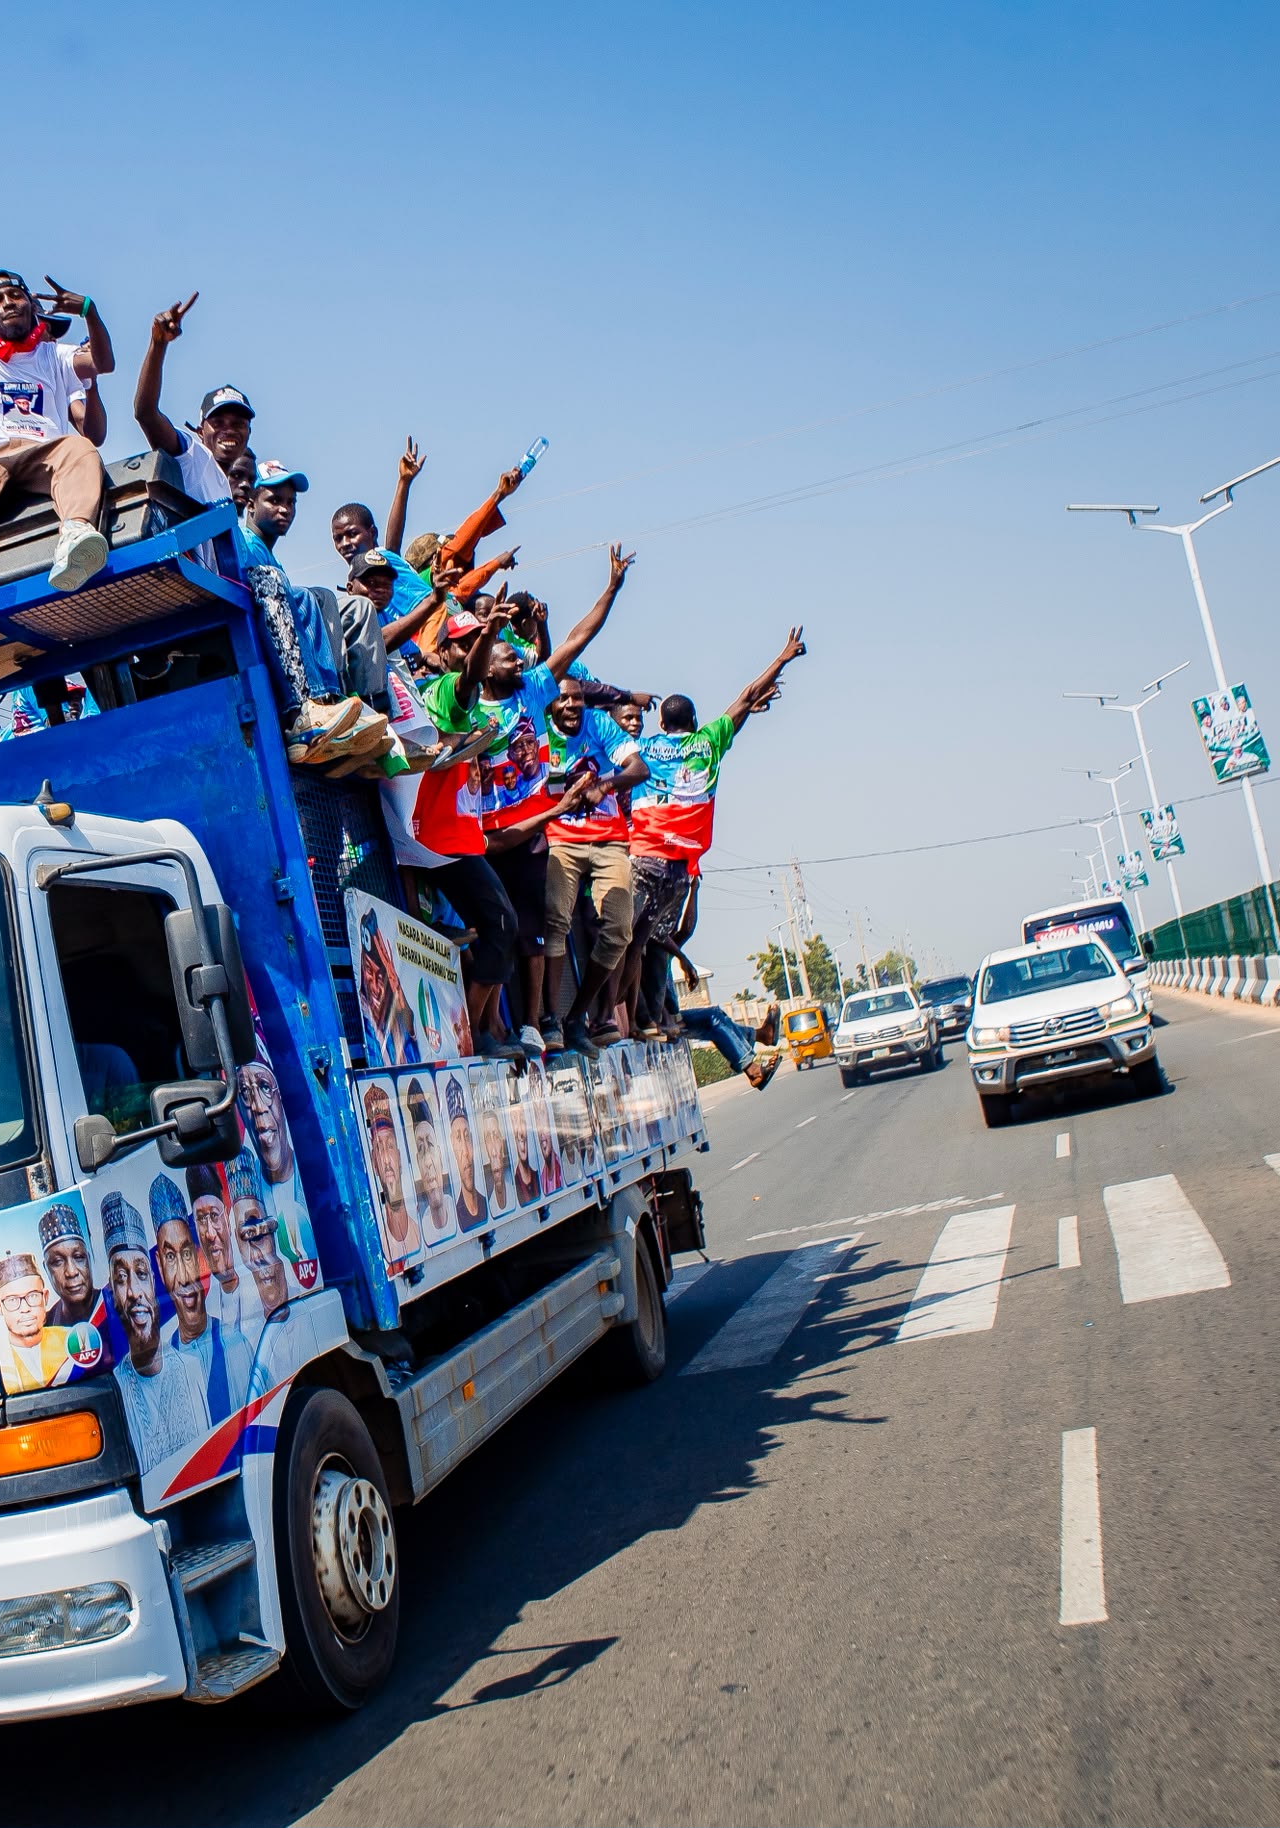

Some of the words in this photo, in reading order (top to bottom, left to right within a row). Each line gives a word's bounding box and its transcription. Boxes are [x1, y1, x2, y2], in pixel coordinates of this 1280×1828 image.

[1077, 917, 1115, 935] NAMU
[298, 1261, 316, 1281] APC
[78, 1350, 98, 1362] APC
